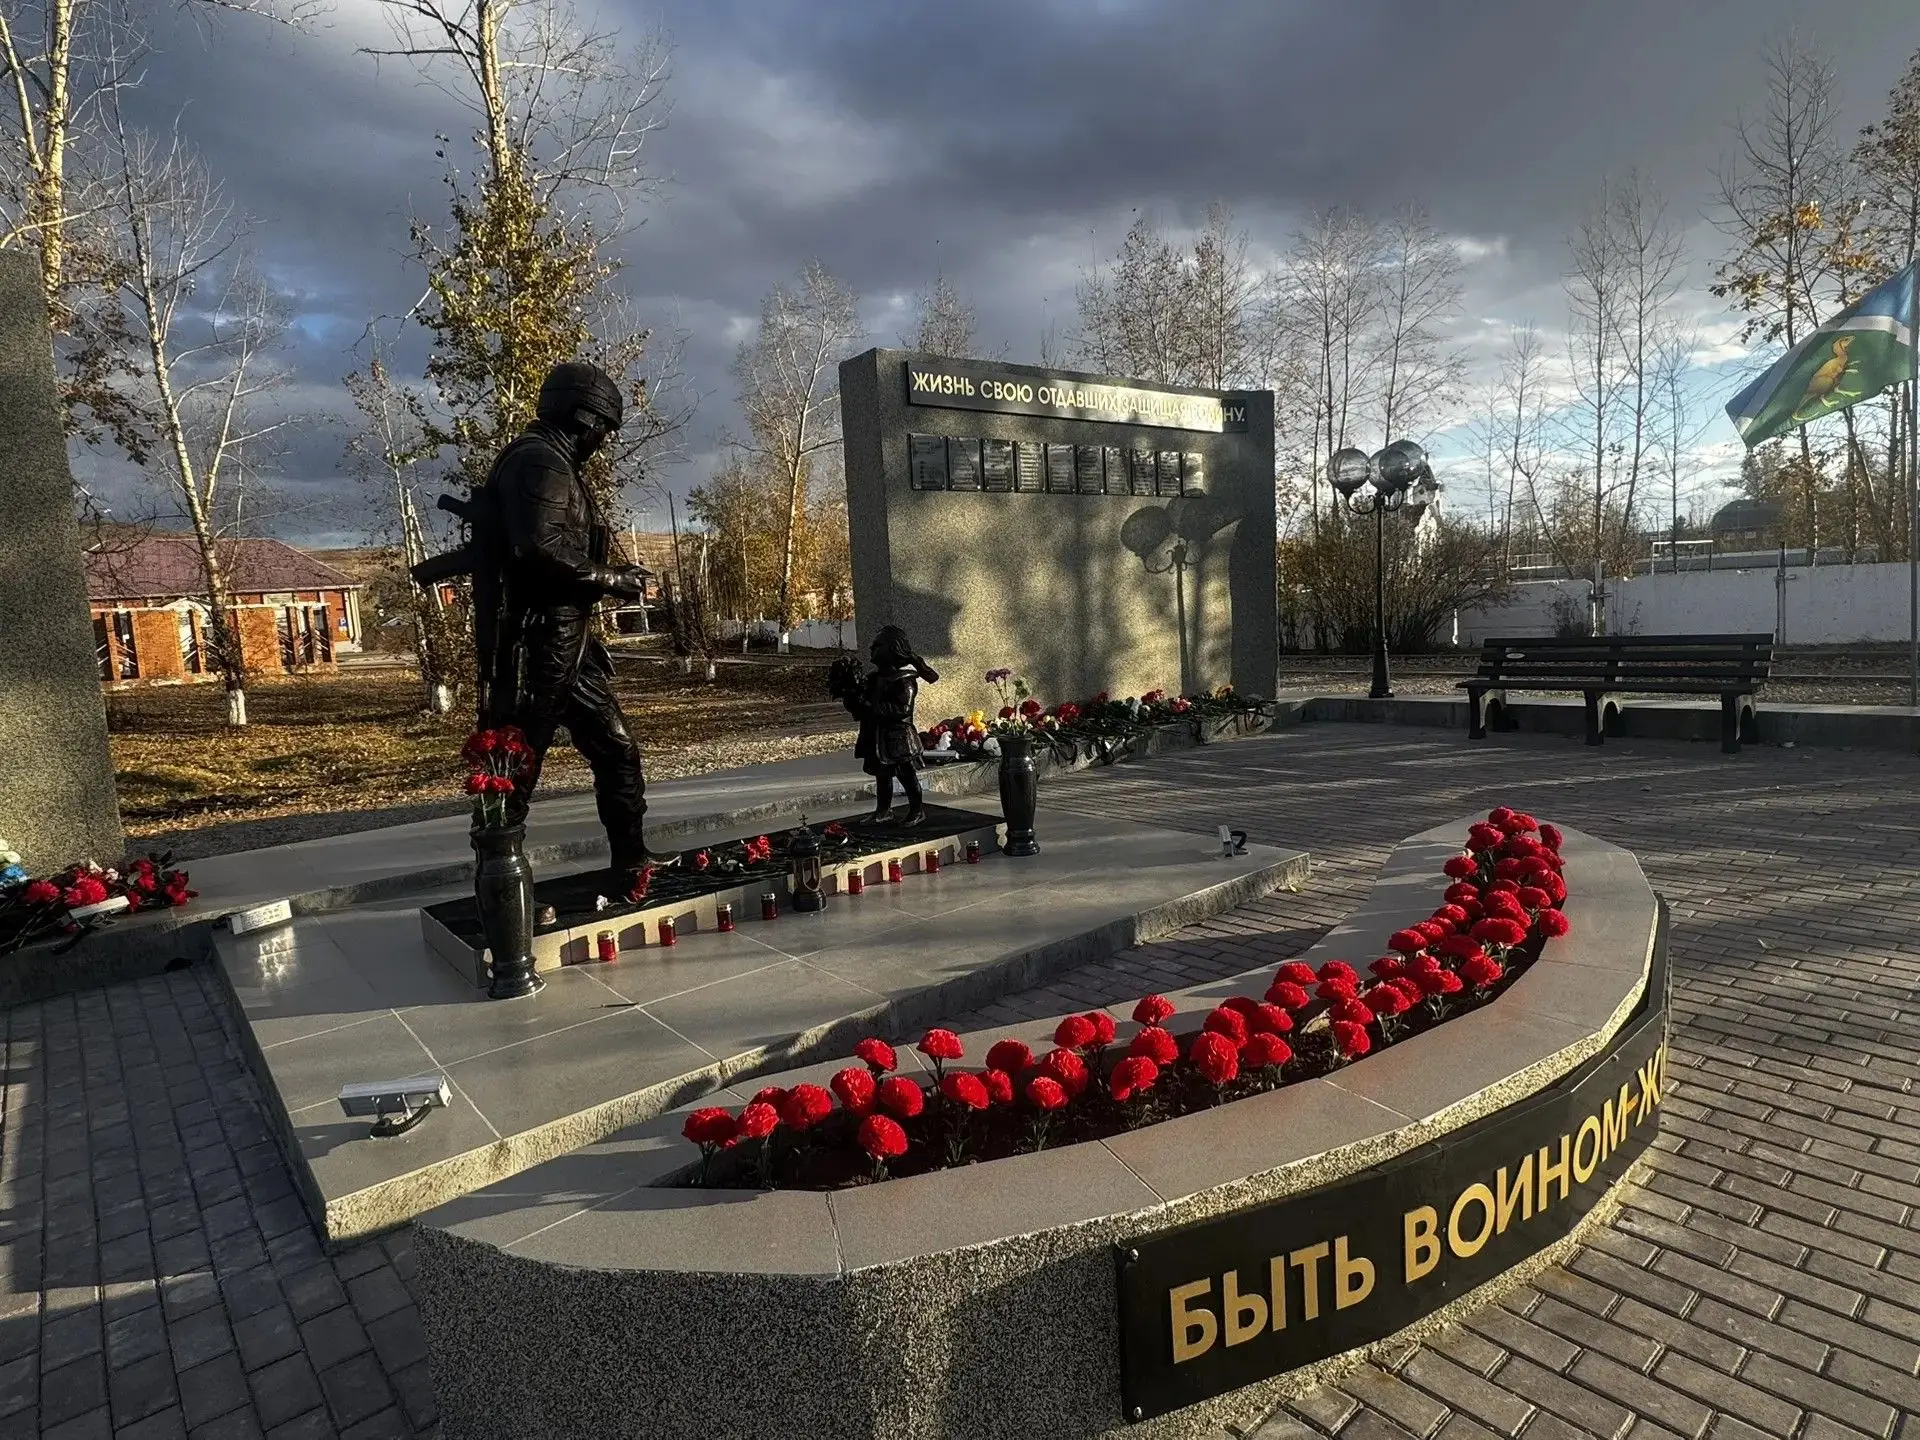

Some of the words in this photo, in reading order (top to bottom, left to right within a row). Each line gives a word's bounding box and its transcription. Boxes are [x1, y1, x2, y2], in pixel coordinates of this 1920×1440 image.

[912, 371, 975, 396] ЖИЗНЬ
[980, 380, 1033, 403] СВОЮ
[1038, 386, 1118, 411] ОТДАВШИХ
[1120, 396, 1187, 418] ЗАЩИЩАЯ
[1169, 1235, 1375, 1364] БЫТЬ
[1404, 1042, 1663, 1284] ВОИНОМ-Ж
